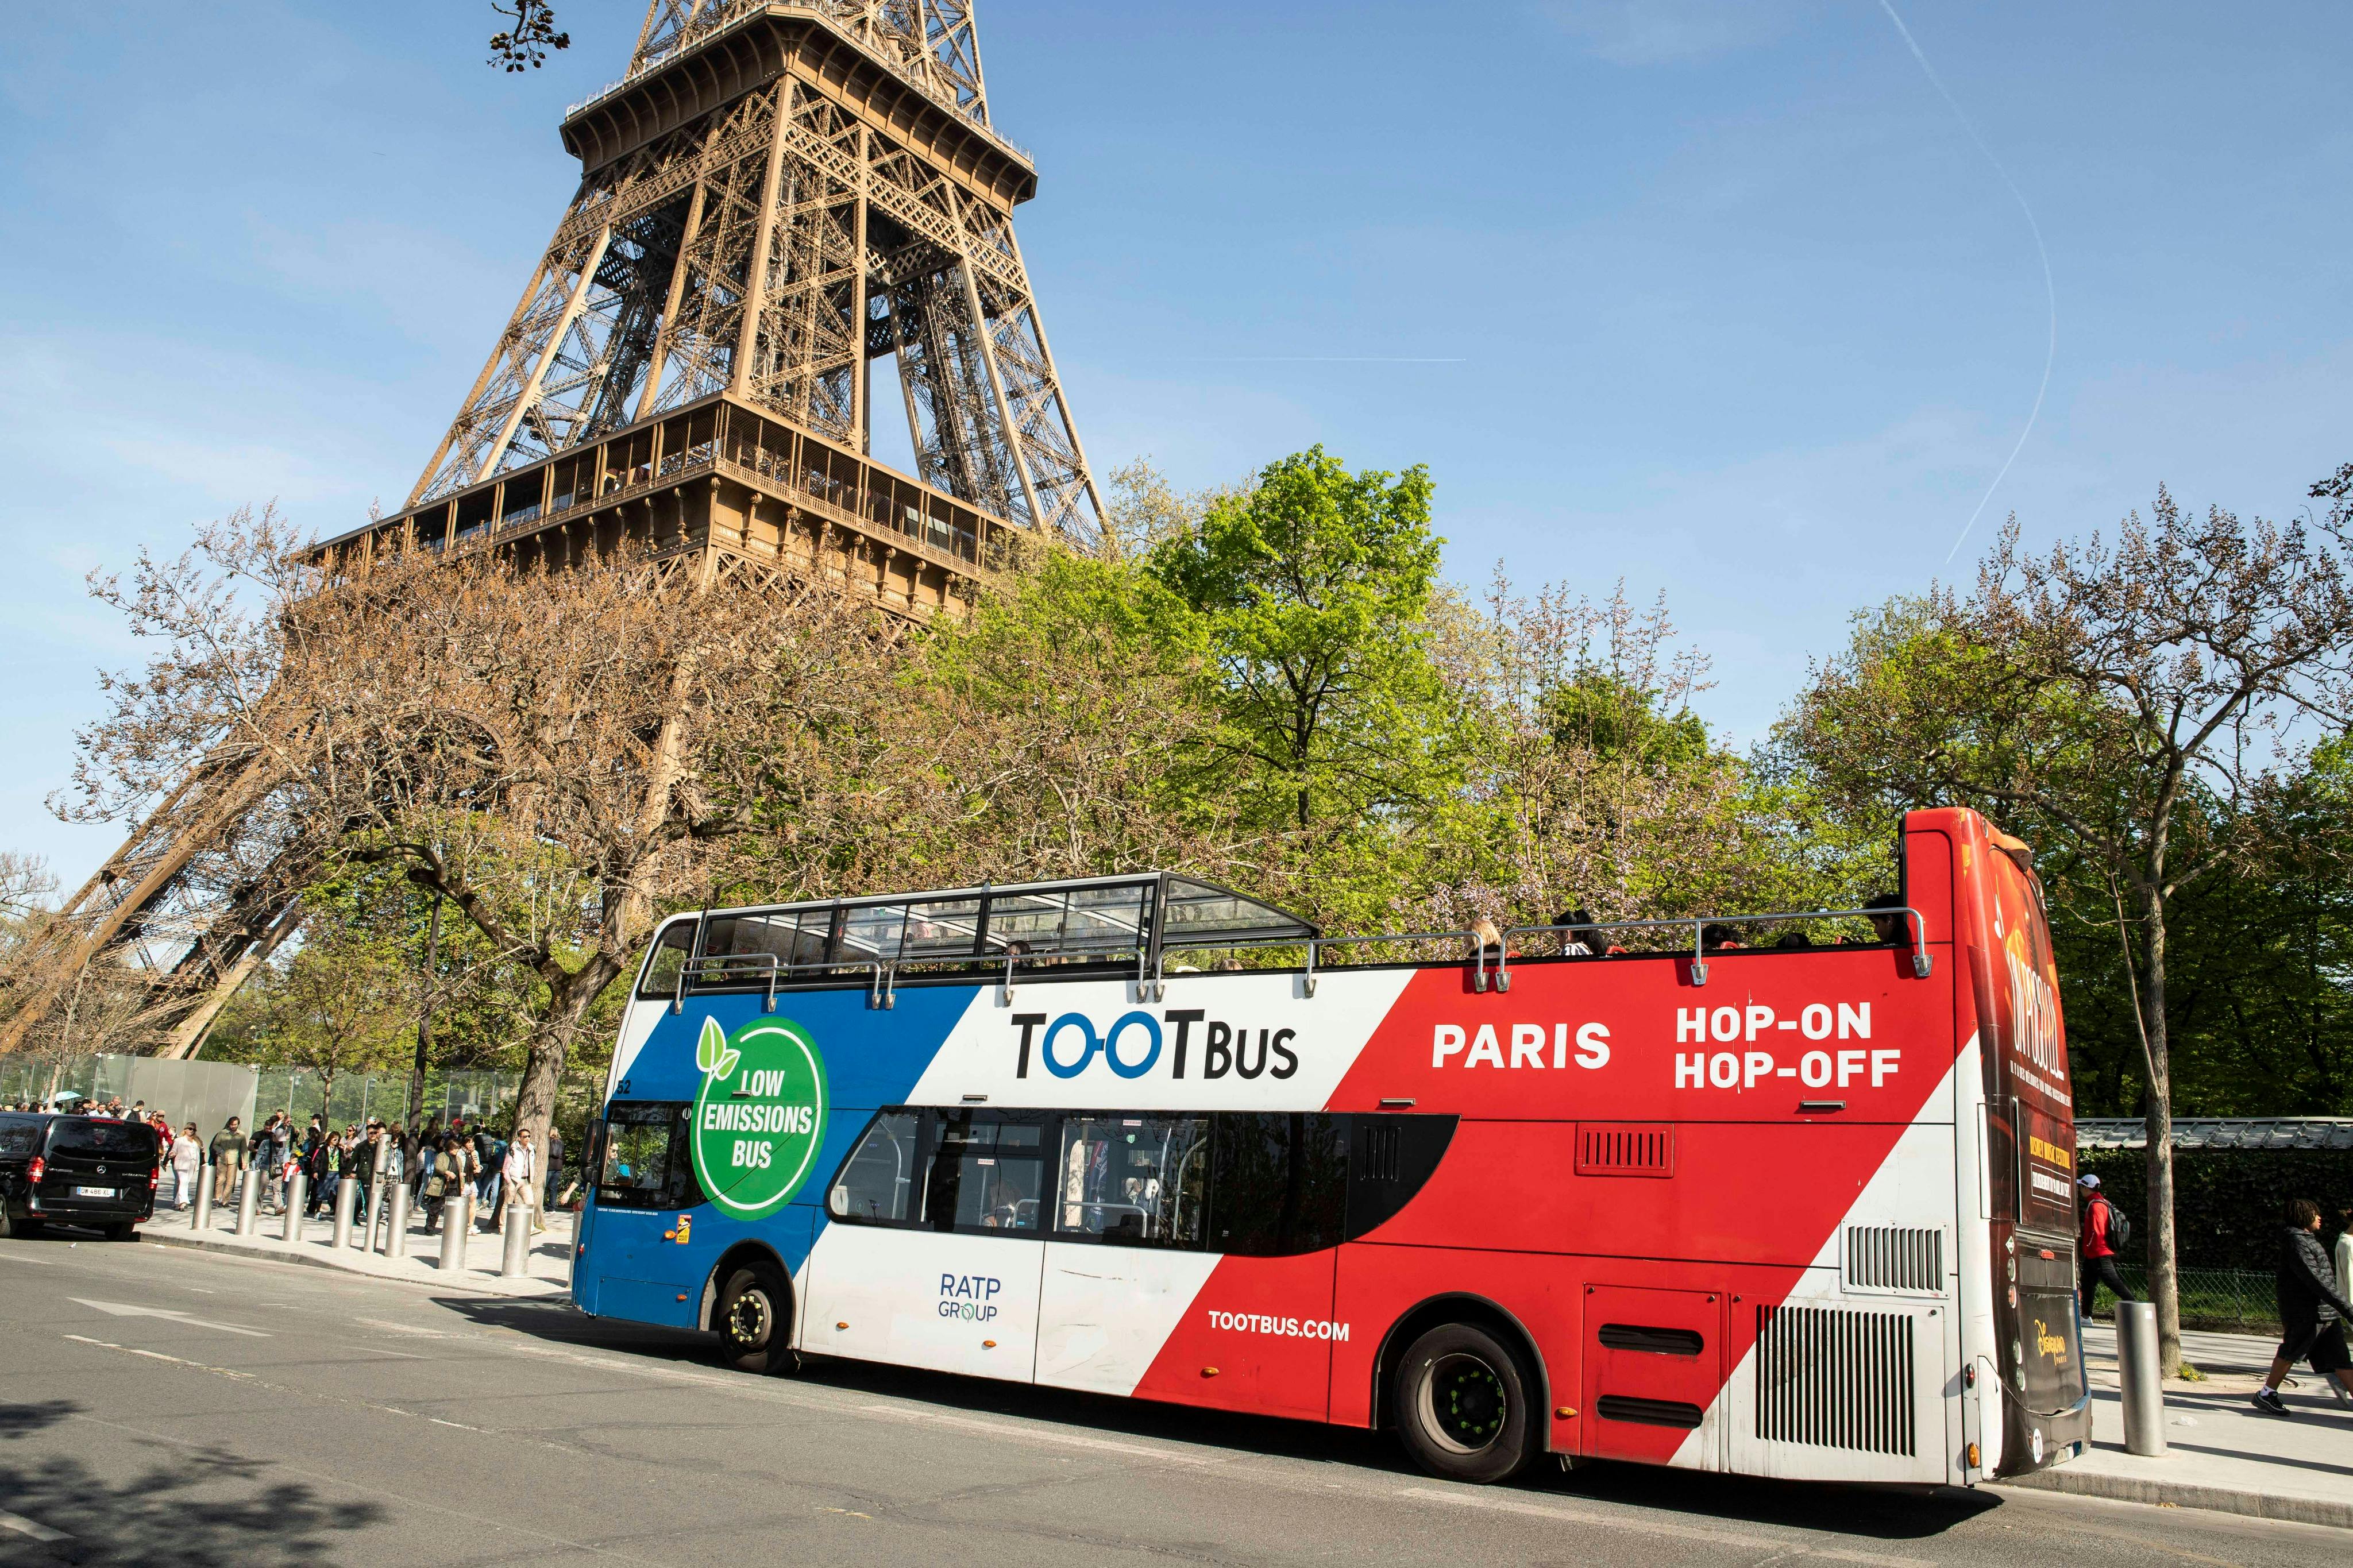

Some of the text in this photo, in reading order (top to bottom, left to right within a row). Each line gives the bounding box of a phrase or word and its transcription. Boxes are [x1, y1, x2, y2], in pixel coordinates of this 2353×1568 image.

[1676, 1002, 1872, 1043] HOP-ON
[1433, 1022, 1611, 1069] PARIS
[1675, 1049, 1901, 1088] HOP-OFF
[616, 1080, 631, 1094] 52
[740, 1070, 785, 1097] LOW
[704, 1104, 812, 1134] EMISSIONS
[732, 1140, 772, 1169] BUS
[2030, 1135, 2044, 1158] DISNEY
[2055, 1146, 2070, 1169] FESTIVAL
[940, 1273, 1001, 1300] RATP
[939, 1301, 997, 1323] GROUP
[1208, 1310, 1349, 1342] TOOTBUS.COM
[2056, 1355, 2067, 1364] PARIS
[2035, 1436, 2041, 1457] 70
